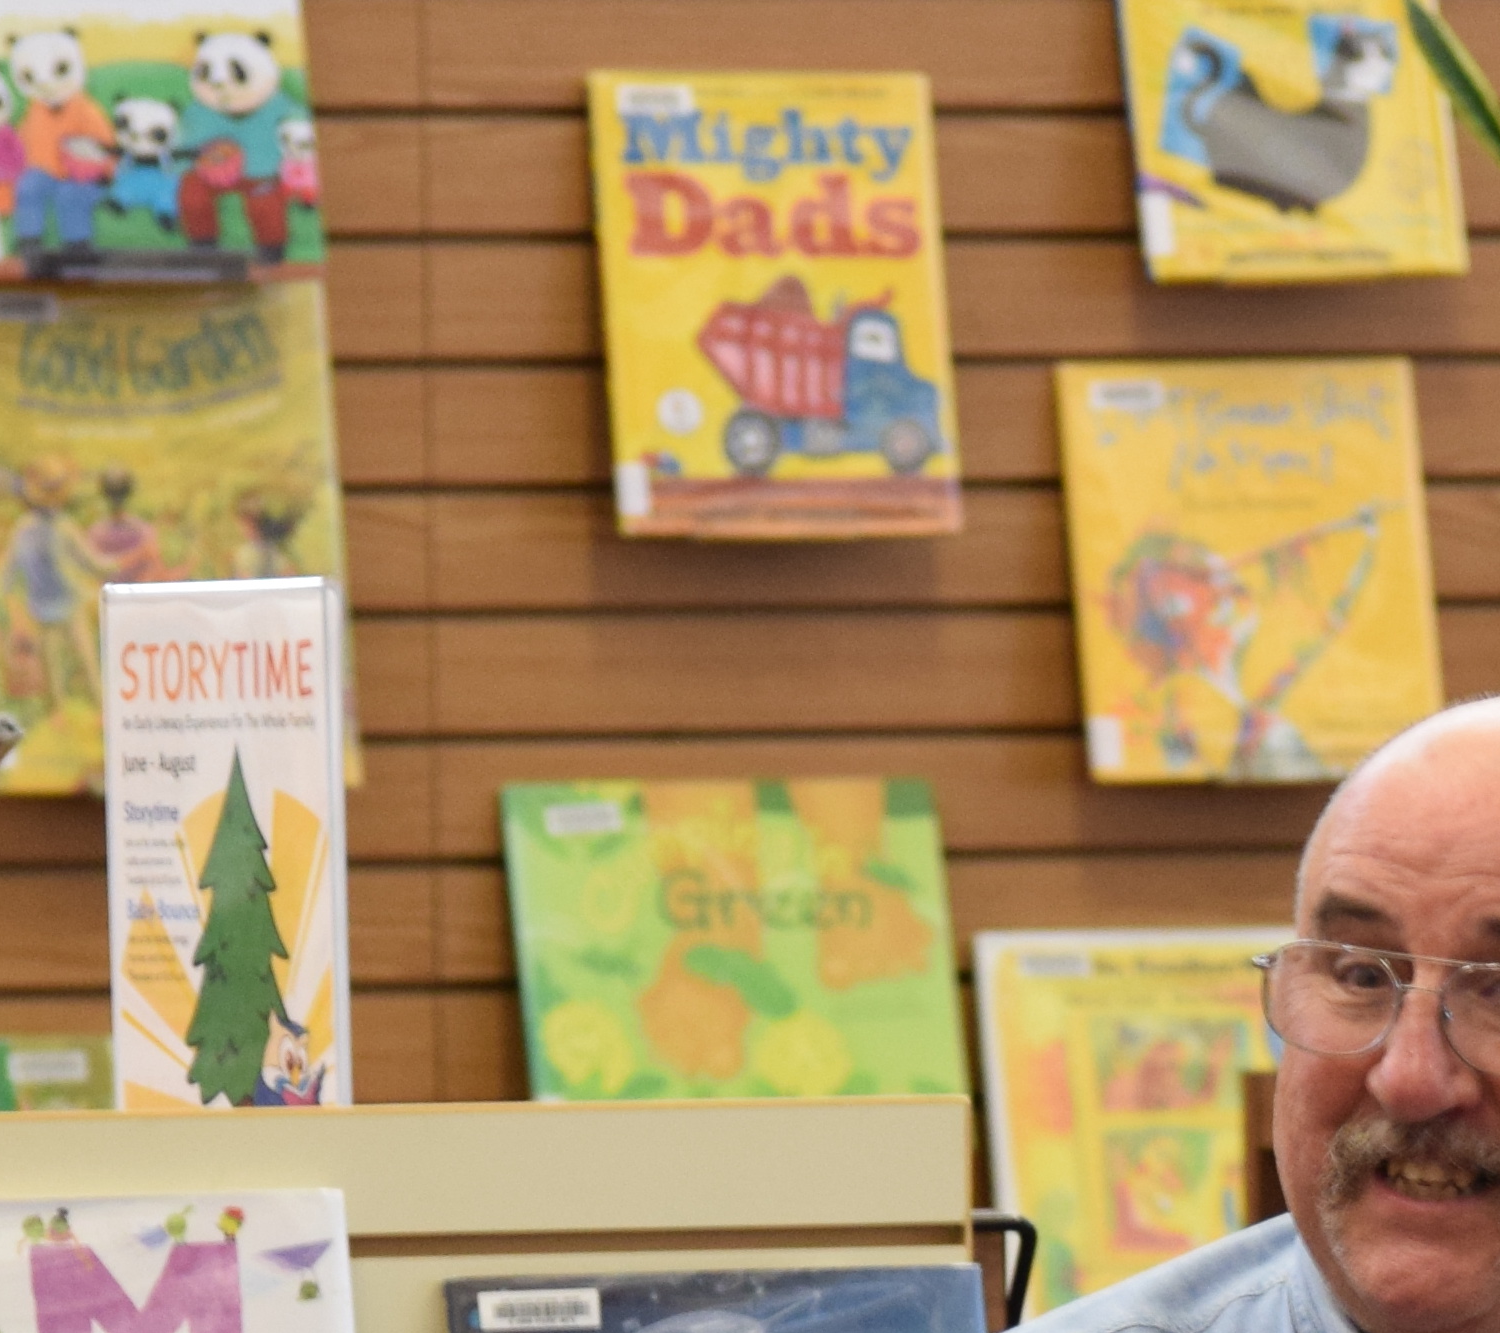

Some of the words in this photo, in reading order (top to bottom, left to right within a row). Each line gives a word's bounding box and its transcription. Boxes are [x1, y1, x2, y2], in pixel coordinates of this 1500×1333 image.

[618, 107, 914, 181] Mighty
[624, 172, 923, 259] Dads
[118, 637, 315, 702] STORYTIME
[122, 753, 148, 776] June
[158, 752, 197, 779] August
[122, 800, 181, 826] Storytime
[656, 866, 874, 932] Green
